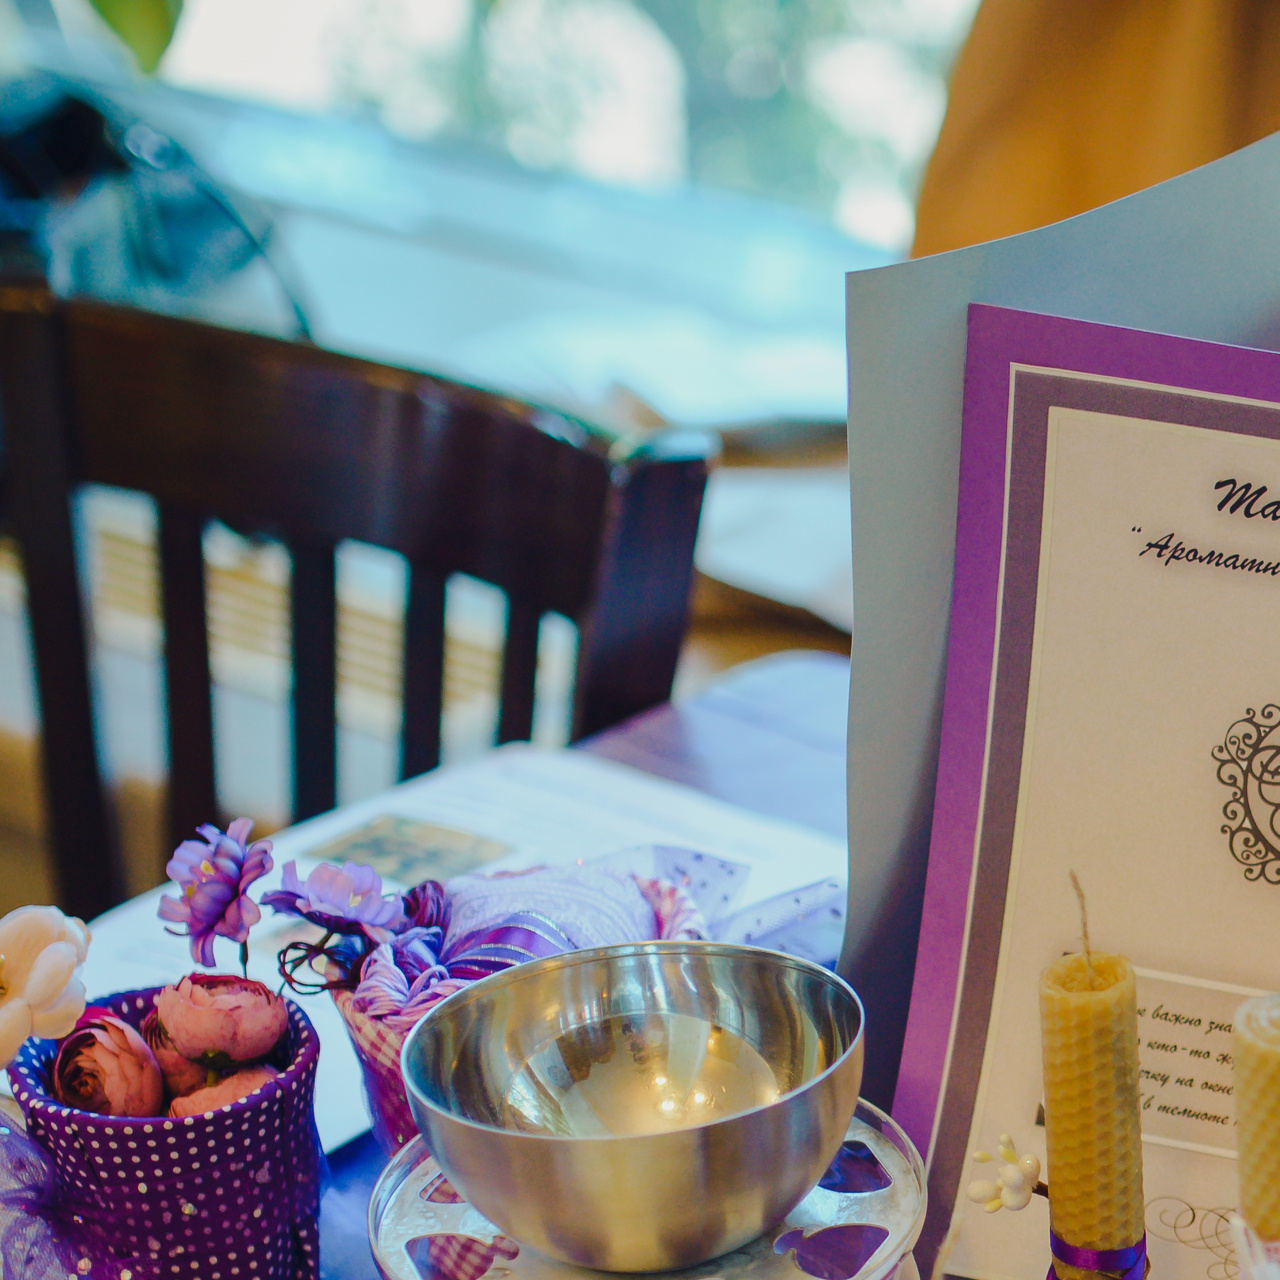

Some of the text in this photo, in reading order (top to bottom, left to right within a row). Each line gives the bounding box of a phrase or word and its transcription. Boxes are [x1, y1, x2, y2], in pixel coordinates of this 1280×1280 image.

[1151, 1004, 1202, 1028] важно
[1204, 1020, 1233, 1035] зна
[1146, 1040, 1211, 1060] кто-то
[1175, 1075, 1194, 1088] на
[1157, 1104, 1230, 1126] темноте
